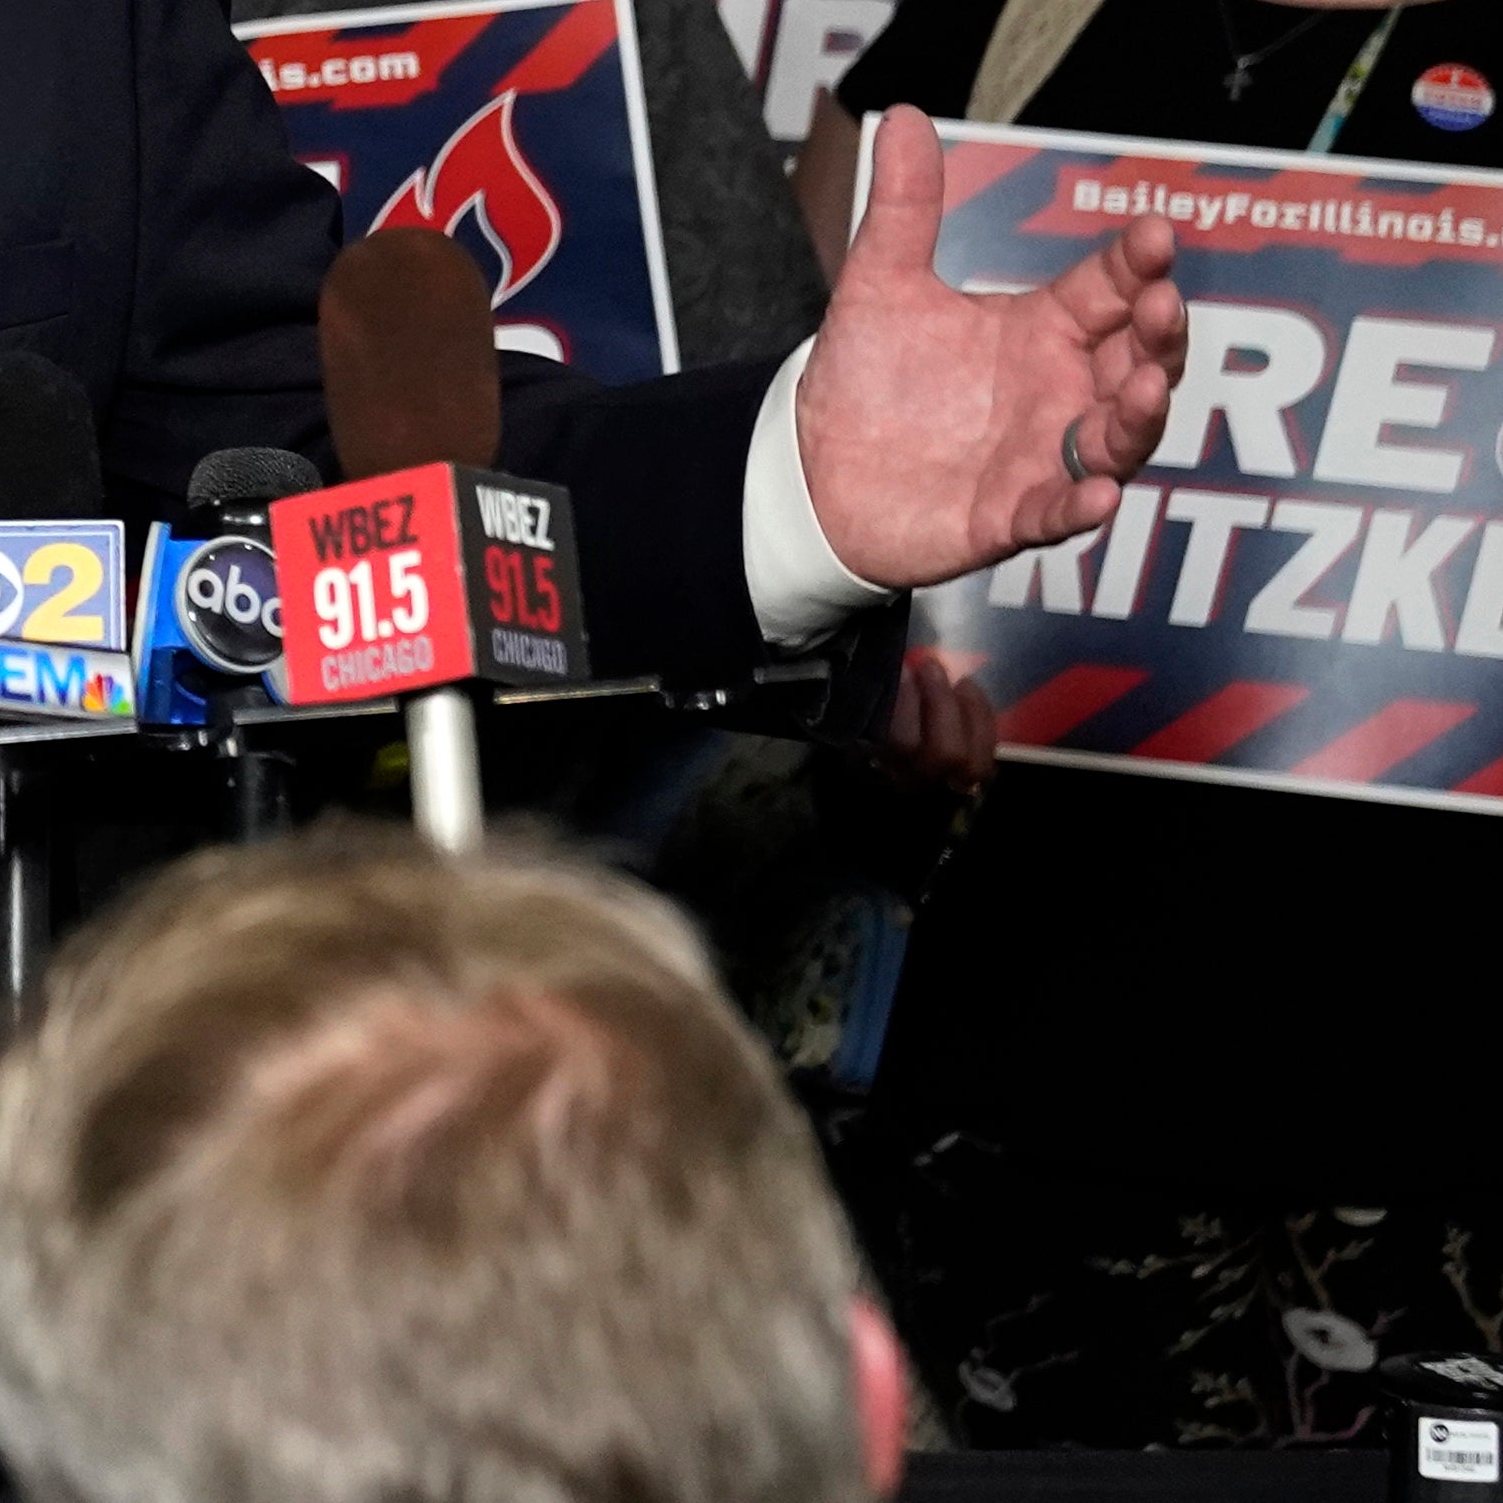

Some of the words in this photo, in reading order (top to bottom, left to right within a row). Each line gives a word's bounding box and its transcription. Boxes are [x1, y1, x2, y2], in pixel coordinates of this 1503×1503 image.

[1073, 178, 1503, 248] BaileyForIllinois.
[309, 494, 421, 563] WBEZ
[475, 484, 556, 552] WBEZ
[21, 542, 103, 642] 2
[313, 550, 429, 650] 91.5
[484, 546, 561, 633] 91.5
[320, 637, 434, 691] CHICAGO
[492, 628, 568, 677] CHICAGO
